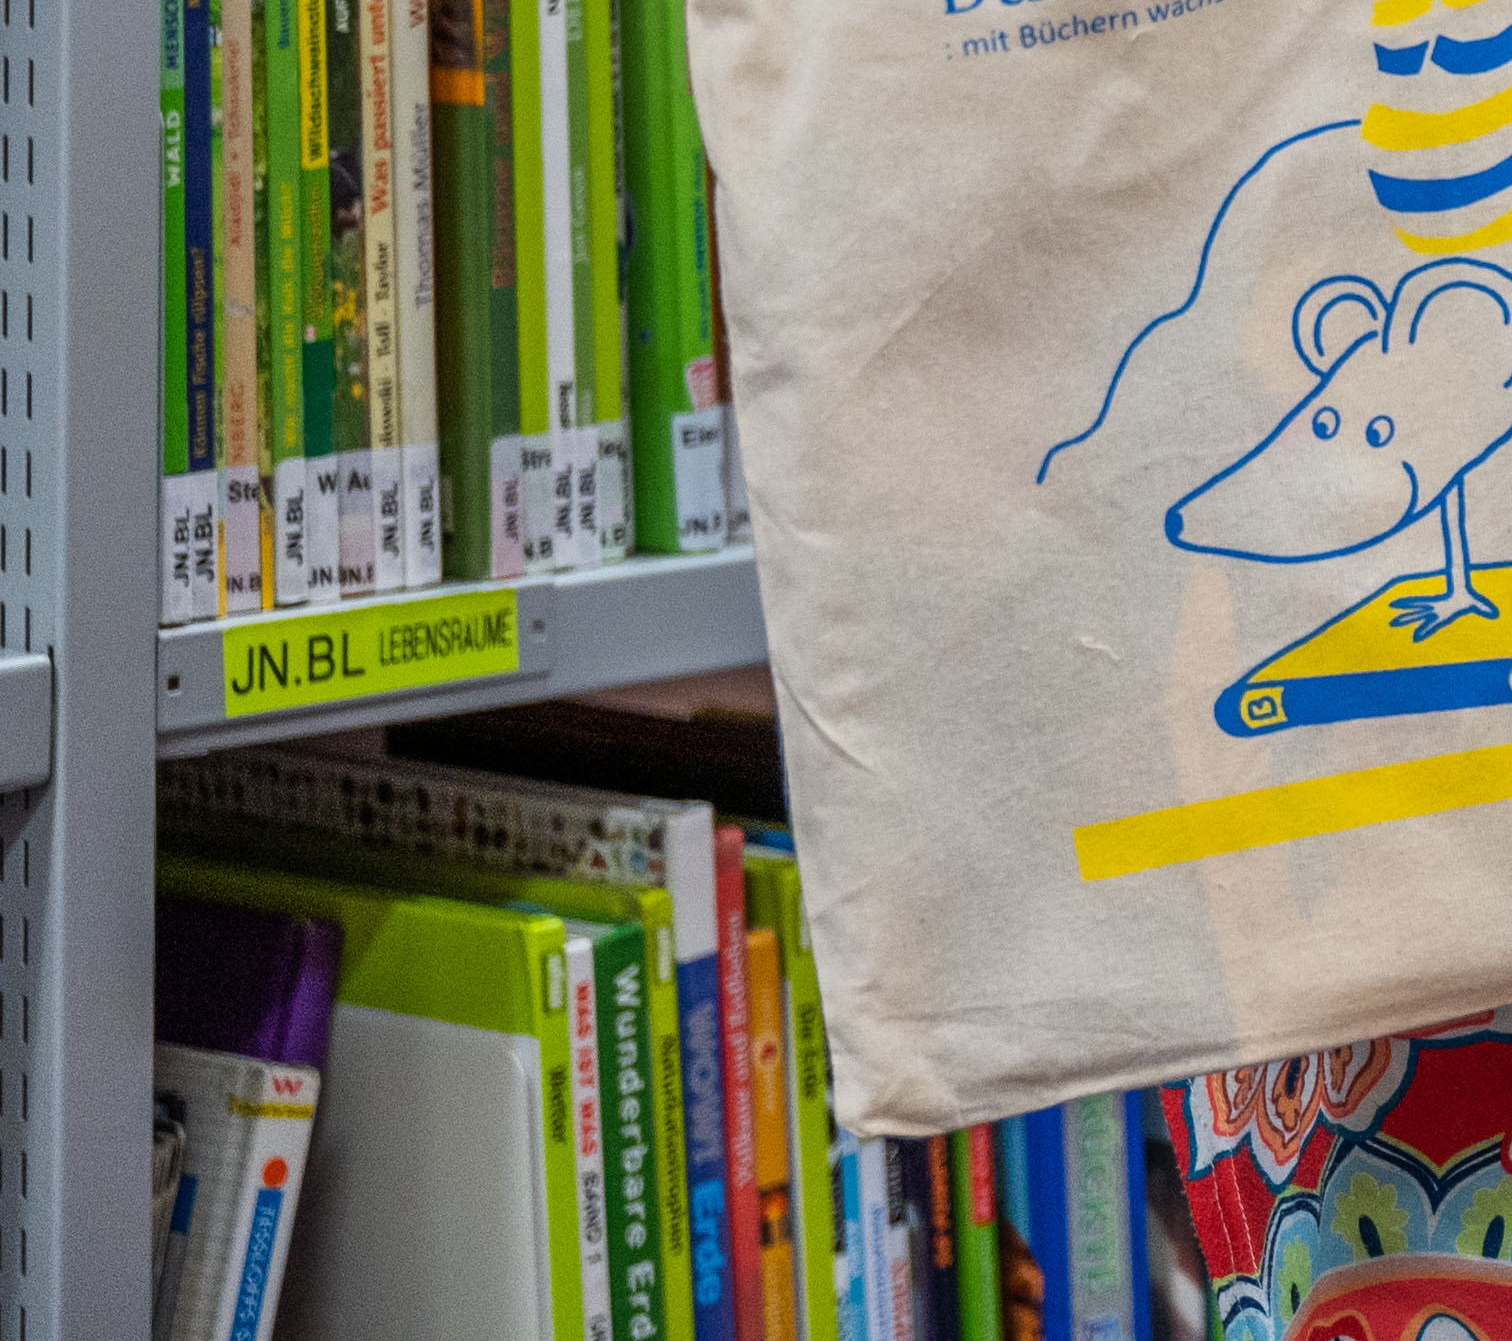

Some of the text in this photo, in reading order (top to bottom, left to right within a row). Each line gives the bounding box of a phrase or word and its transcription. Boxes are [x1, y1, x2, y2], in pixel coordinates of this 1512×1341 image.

[962, 28, 1012, 58] mit
[1017, 7, 1138, 50] Büchern
[366, 54, 393, 153] passiert
[372, 160, 390, 215] Was
[231, 628, 367, 697] JN.BL
[613, 962, 649, 1249] Wunderbare
